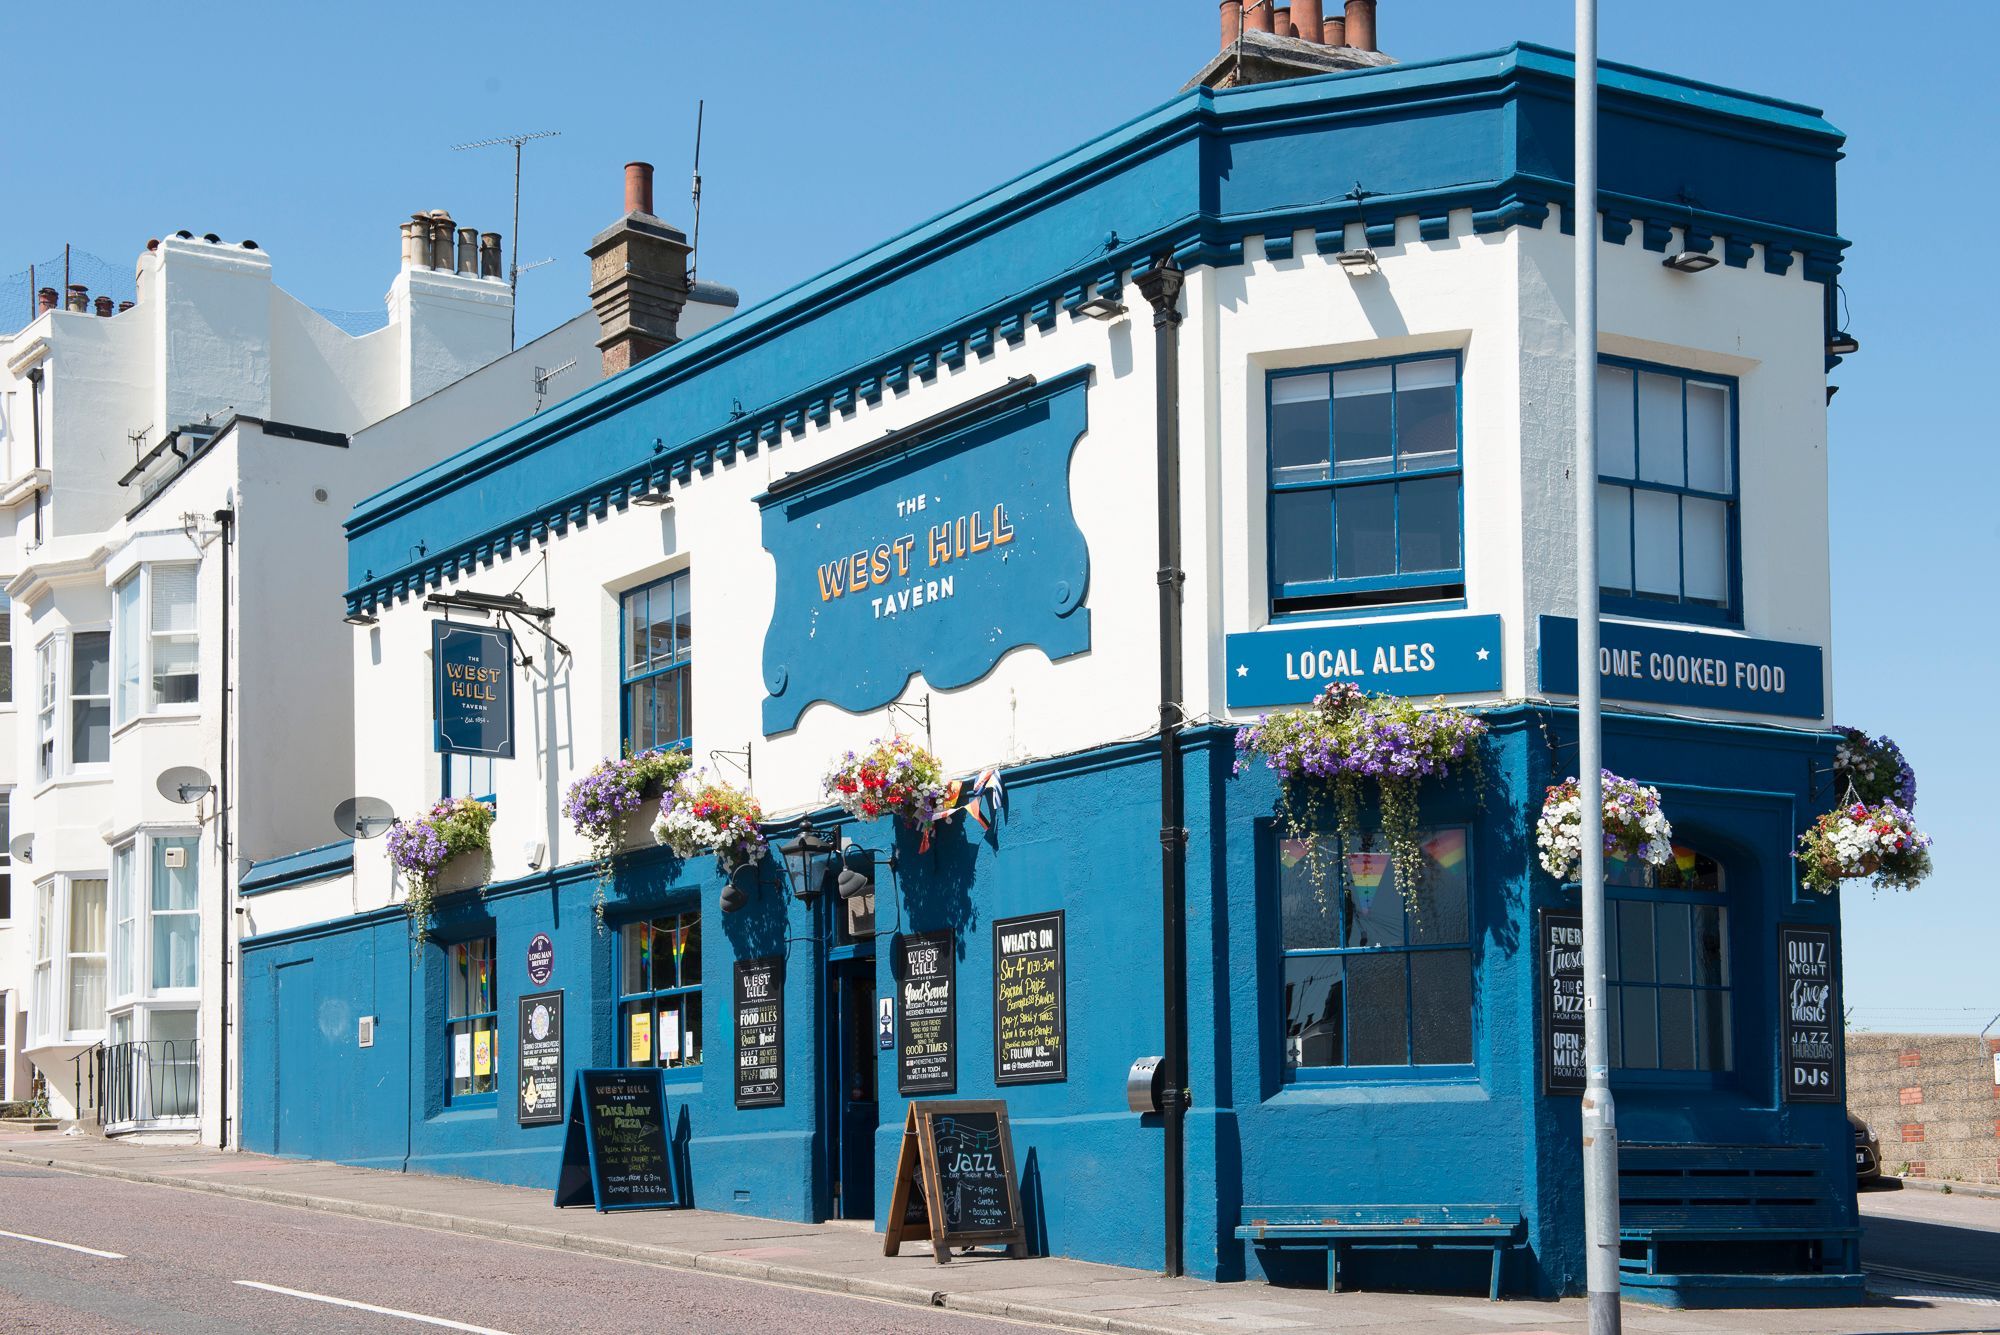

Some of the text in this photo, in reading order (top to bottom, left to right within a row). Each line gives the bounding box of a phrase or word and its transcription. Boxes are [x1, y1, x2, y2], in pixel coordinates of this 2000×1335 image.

[896, 494, 926, 517] THE
[818, 503, 1014, 602] WEST HILL
[872, 576, 954, 619] TAVERN
[1286, 643, 1435, 681] LOCAL ALES
[446, 662, 501, 684] WEST
[1600, 648, 1786, 693] OME COOKED FOOD
[452, 681, 497, 702] HILL
[462, 702, 488, 711] TAVERN
[1001, 929, 1053, 954] WHAT'S ON
[1551, 926, 1583, 945] EVER
[529, 950, 552, 961] LONG MAN
[908, 948, 940, 964] WEST
[1788, 940, 1827, 966] QUIZ
[1547, 944, 1584, 977] tuesd
[912, 962, 938, 976] HILL
[1789, 964, 1827, 976] NIGHT
[744, 973, 771, 988] WEST
[1553, 978, 1561, 995] 2
[1562, 980, 1575, 994] FOR
[746, 985, 769, 998] HILL
[923, 980, 949, 1003] Served
[1790, 978, 1821, 1010] Live
[760, 1004, 777, 1012] SUSSEX
[1553, 994, 1584, 1012] PIZZ
[1588, 997, 1593, 1008] 1
[740, 1013, 759, 1026] FOOD
[760, 1010, 778, 1024] ALES
[1552, 1012, 1570, 1020] FROM
[1792, 1005, 1826, 1022] MUSIC
[740, 1028, 758, 1036] SUNDAY
[759, 1026, 777, 1034] LIVE
[1553, 1032, 1579, 1049] OPEN
[1792, 1032, 1829, 1044] JAZZ
[906, 1042, 948, 1056] GOOD TIMES
[1010, 1046, 1033, 1060] FOLLOW
[1792, 1043, 1833, 1059] THURSDAYS
[740, 1056, 759, 1067] BEER
[1553, 1049, 1579, 1067] MIC
[912, 1067, 921, 1075] GET
[1554, 1066, 1572, 1077] FROM
[1794, 1067, 1829, 1086] DJs
[596, 1084, 650, 1095] WEST HILL
[743, 1086, 754, 1094] COME
[596, 1103, 651, 1117] TAKE AWAY
[614, 1117, 642, 1129] PIZZA
